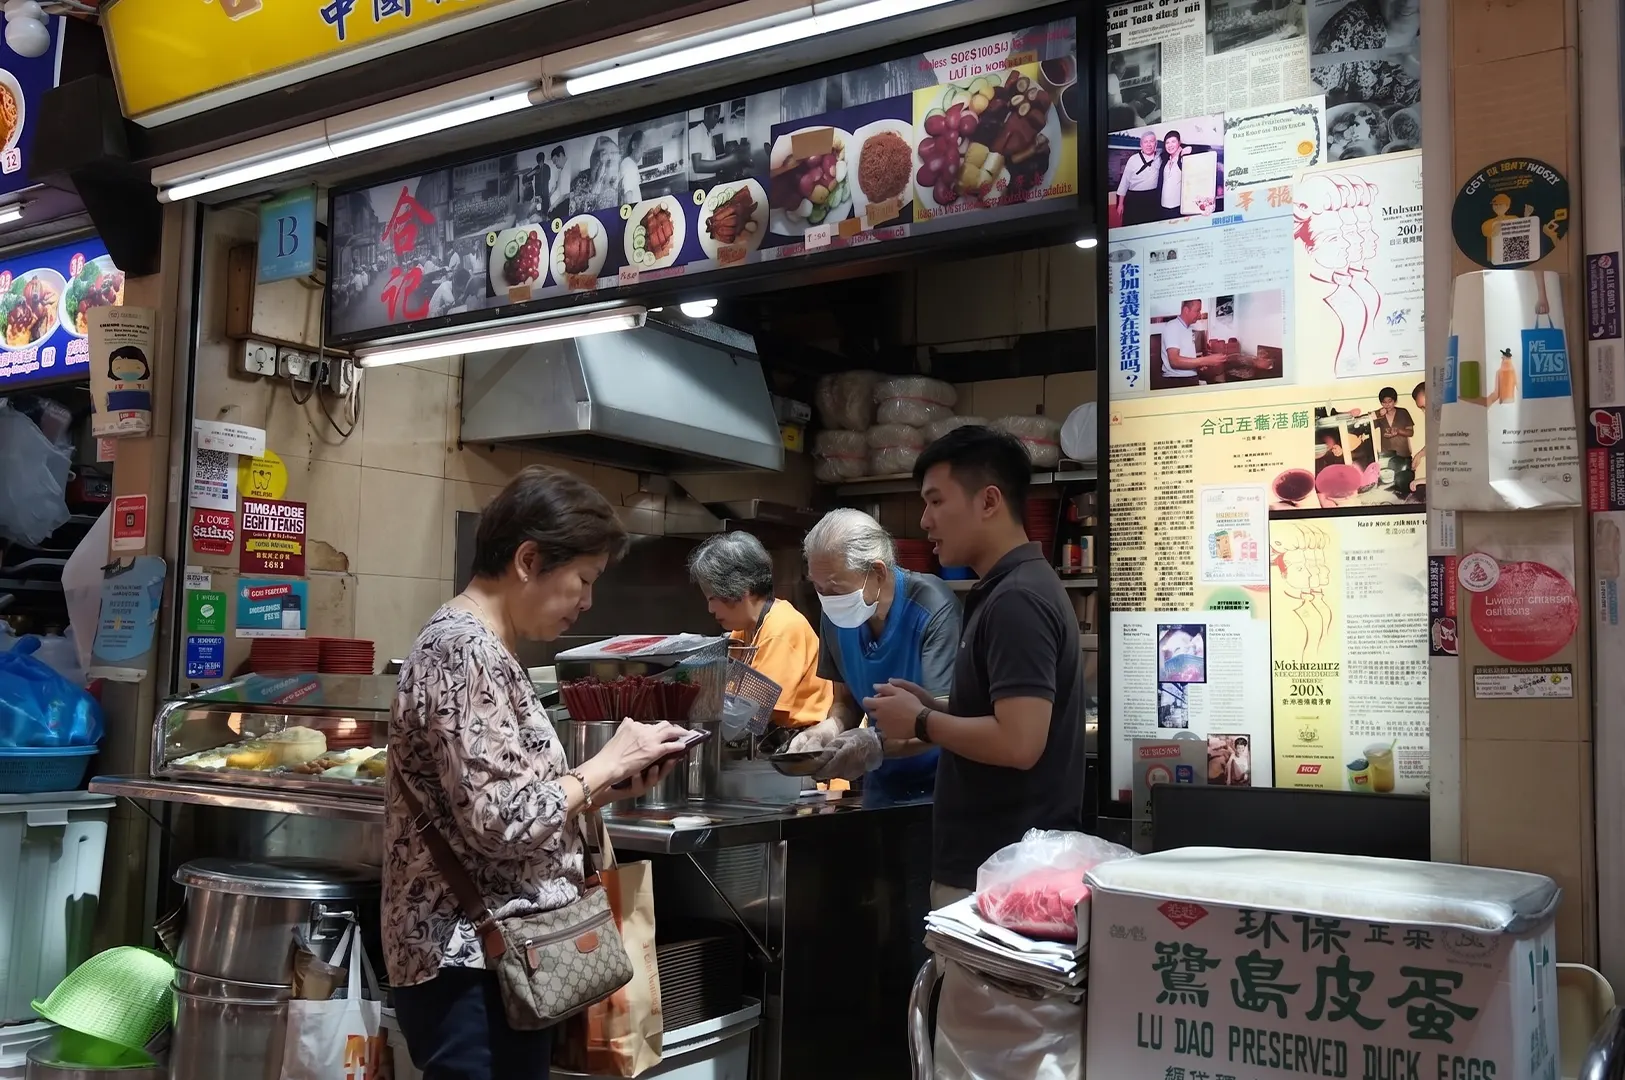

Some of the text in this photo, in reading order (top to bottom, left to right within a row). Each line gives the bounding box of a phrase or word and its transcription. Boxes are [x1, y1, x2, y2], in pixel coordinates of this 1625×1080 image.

[277, 216, 299, 258] B
[1137, 1012, 1496, 1080] LU DAO PRESERVED DUCK EGGS
